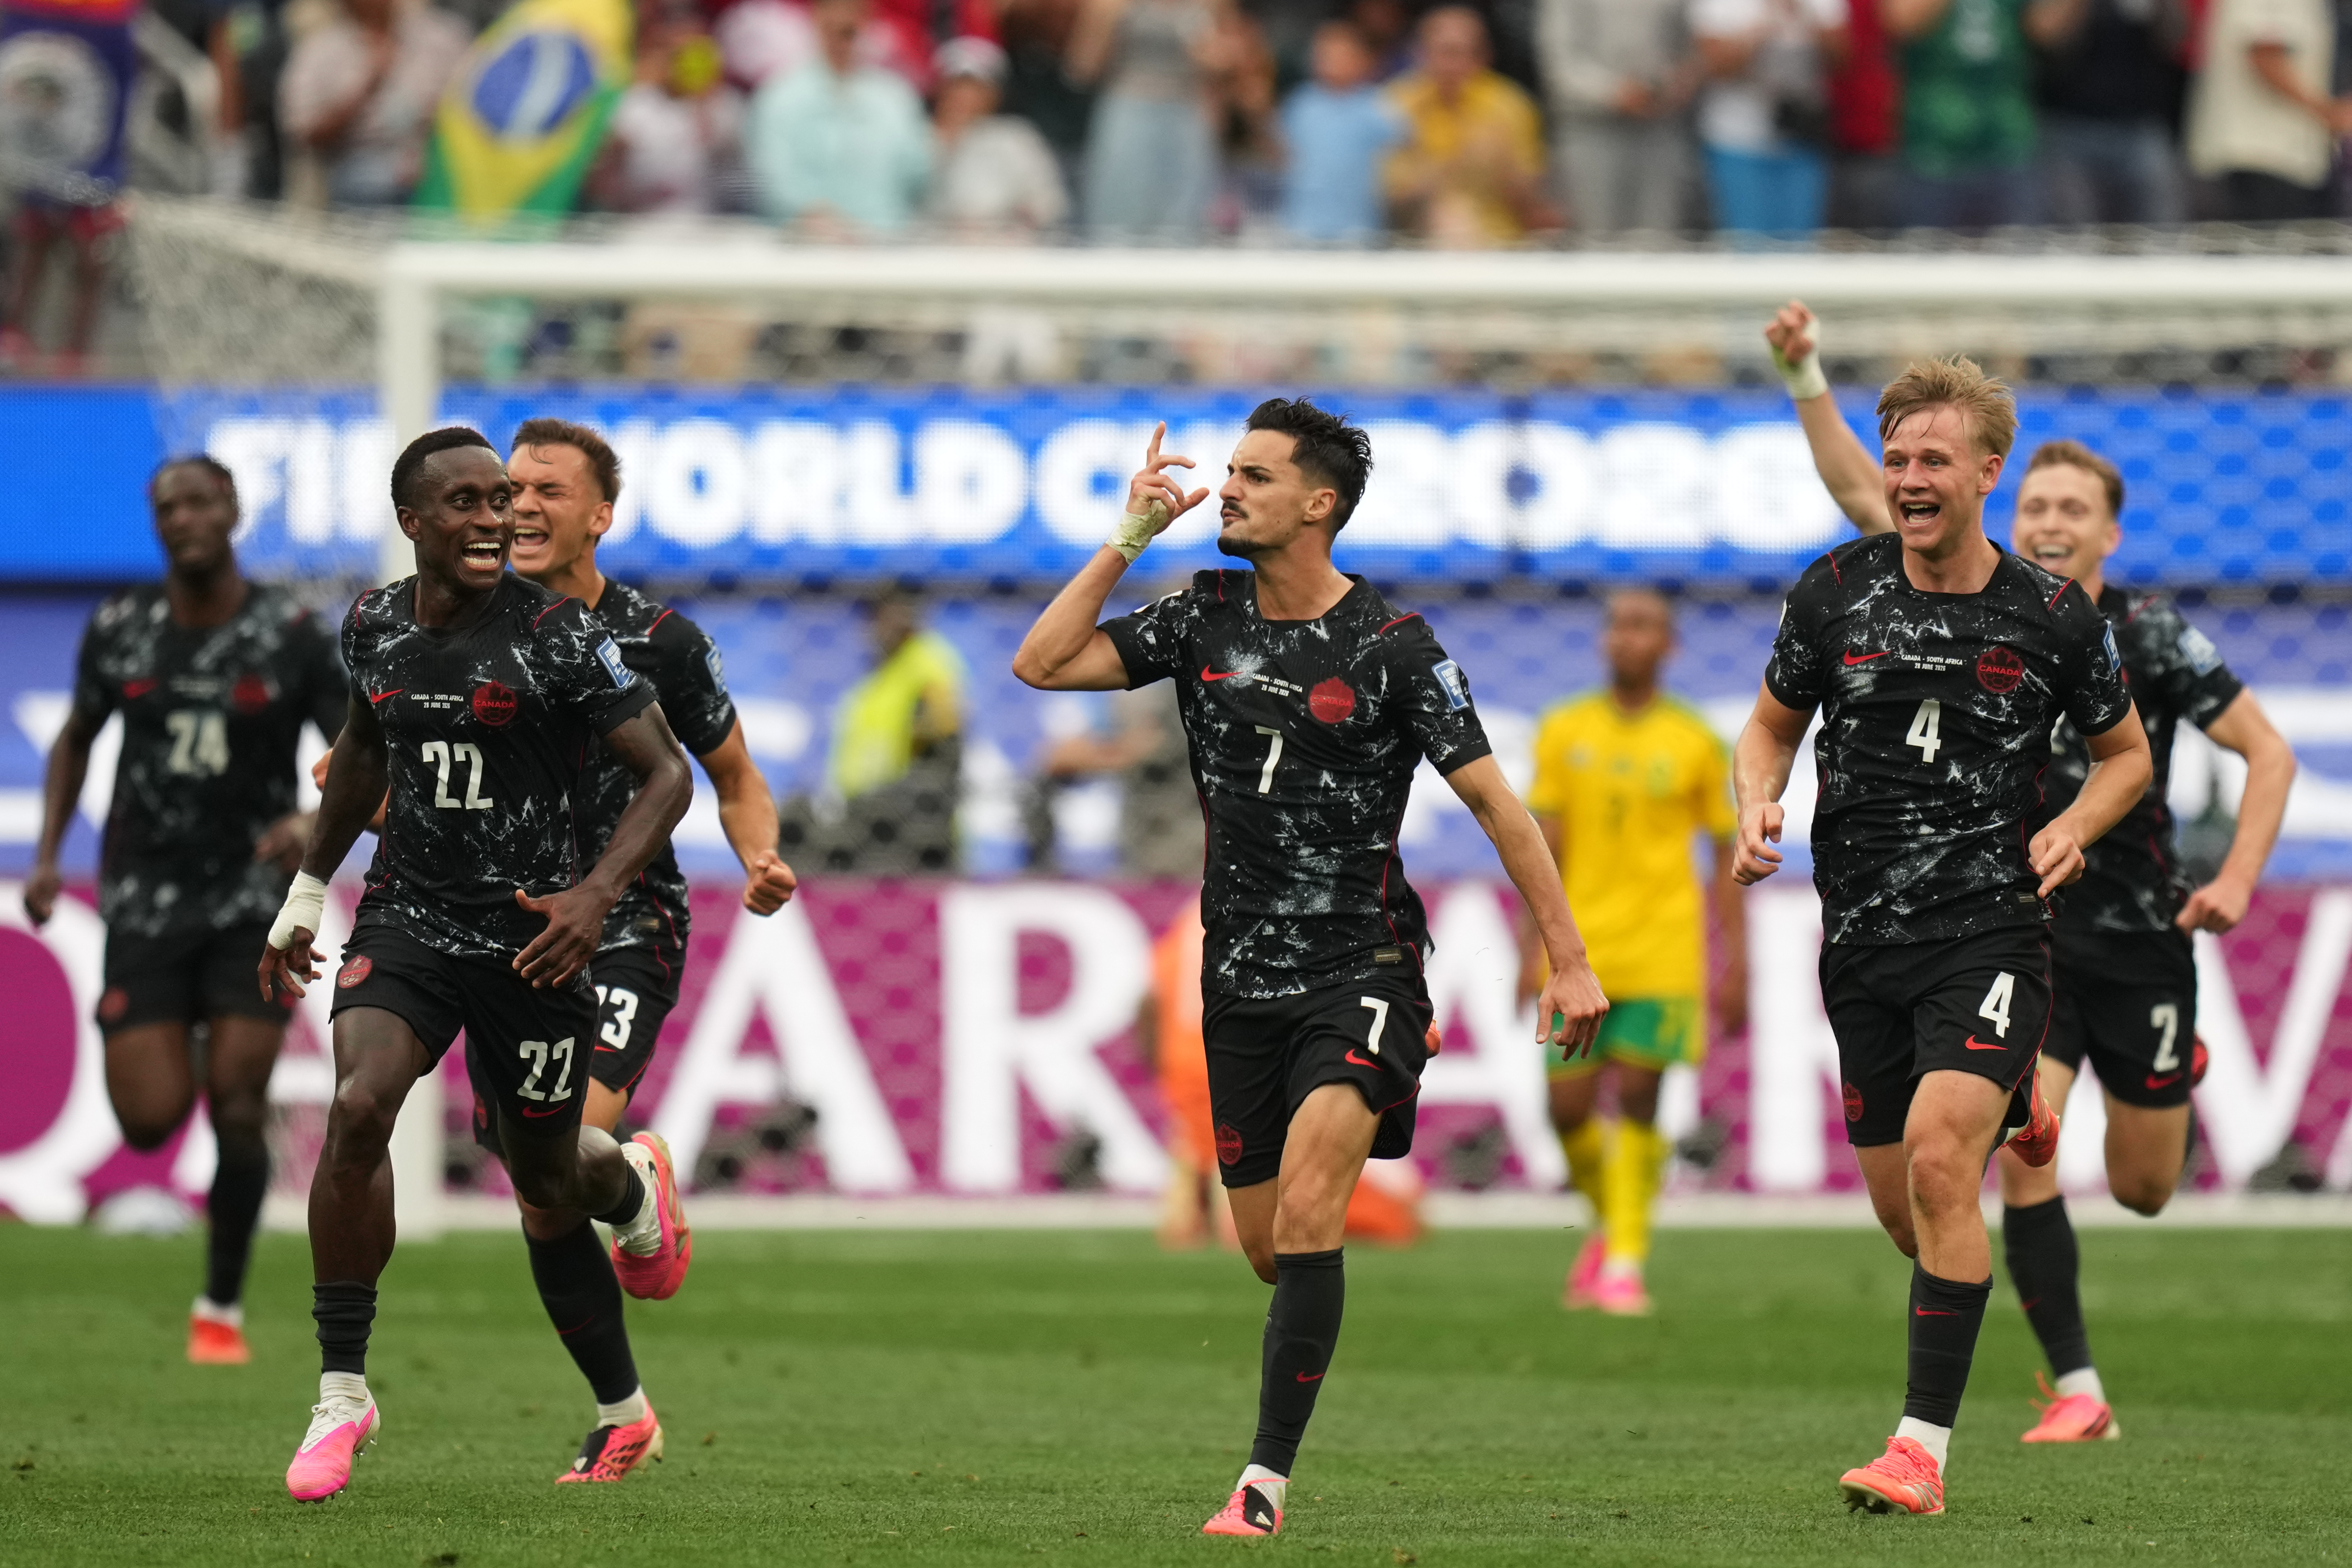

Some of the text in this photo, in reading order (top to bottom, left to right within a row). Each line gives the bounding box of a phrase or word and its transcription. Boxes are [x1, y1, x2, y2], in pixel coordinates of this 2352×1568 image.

[1252, 673, 1269, 682] CANADA
[1273, 678, 1289, 688] SOUTH
[1279, 688, 1289, 696] 2026
[1312, 694, 1353, 707] CANADA
[1979, 665, 2019, 677] CANADA
[474, 700, 514, 708] CANADA
[1906, 699, 1941, 763] 4
[166, 710, 229, 776] 24
[1255, 725, 1283, 793] 7
[422, 741, 493, 810] 22
[1361, 996, 1389, 1055] 7
[1979, 971, 2015, 1038] 4
[517, 1037, 575, 1102] 22
[2150, 1003, 2180, 1072] 2
